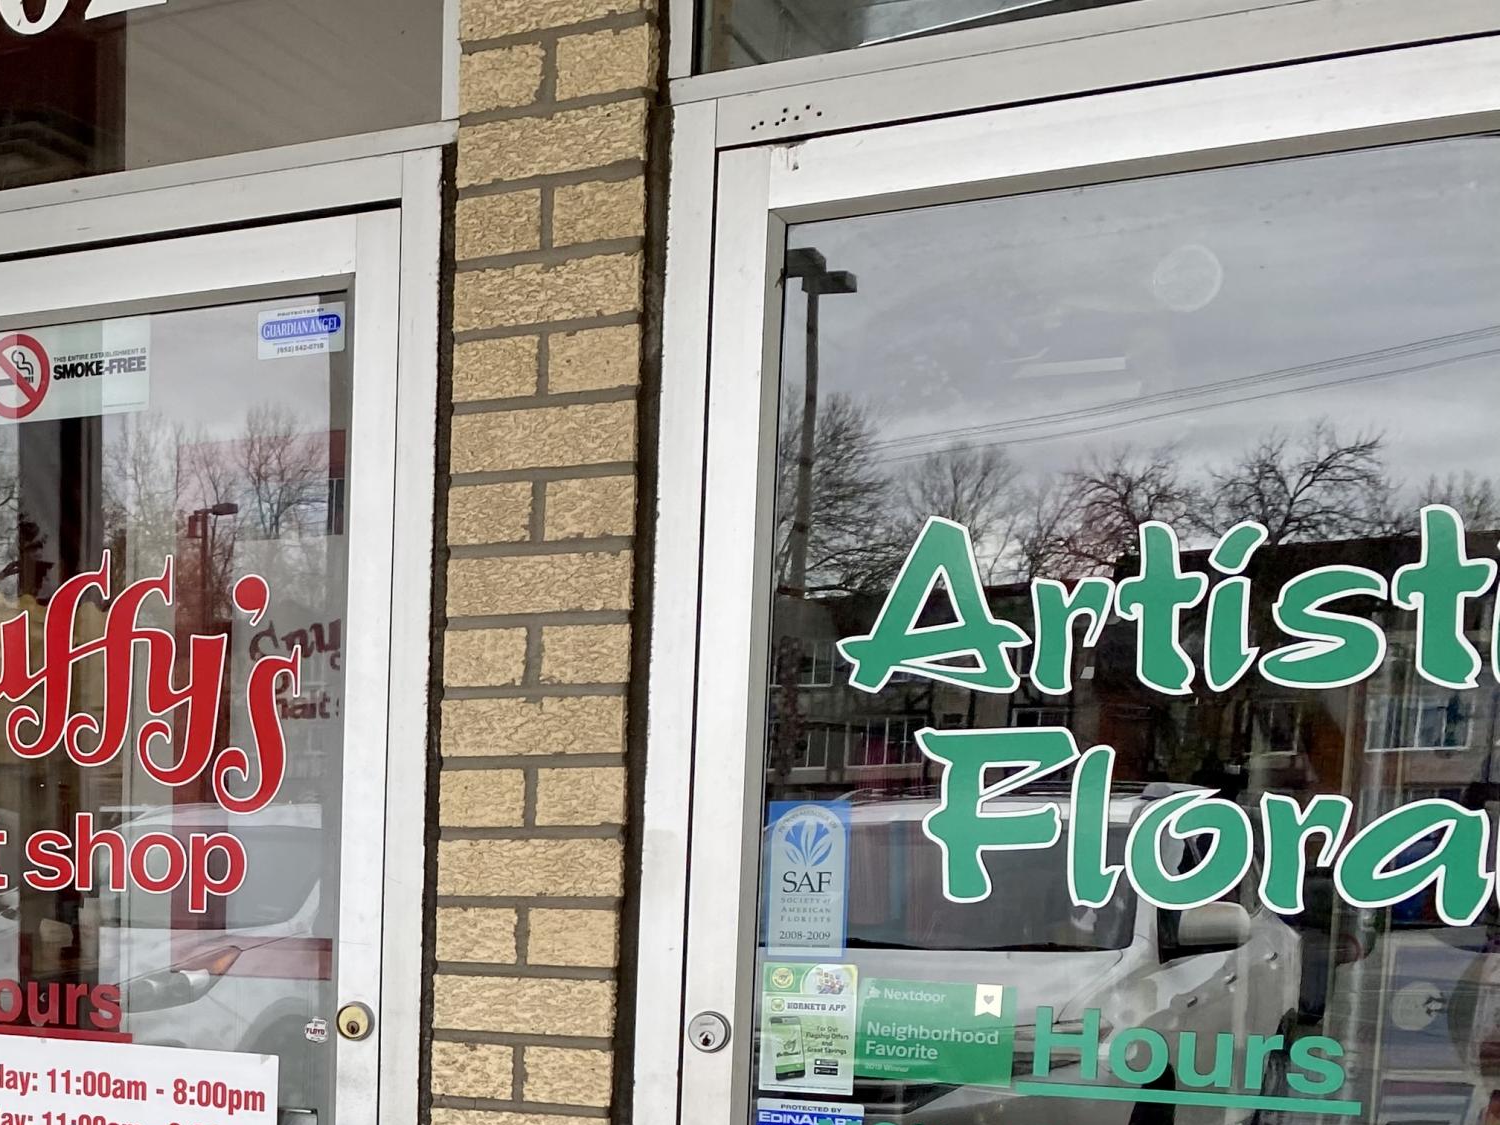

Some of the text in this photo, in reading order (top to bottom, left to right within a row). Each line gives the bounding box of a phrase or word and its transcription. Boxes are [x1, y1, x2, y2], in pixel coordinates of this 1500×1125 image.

[263, 316, 338, 338] GUARDIAN ANGEL
[53, 355, 66, 363] THIS
[67, 352, 89, 362] ENTIRE
[53, 355, 147, 381] SMOKE-FREE
[837, 503, 1500, 694] Artist
[914, 726, 1500, 926] Flora
[23, 812, 248, 914] shop
[782, 871, 832, 893] SAF
[780, 914, 831, 923] FLORISTS
[781, 906, 831, 914] AMERICAN
[779, 930, 831, 941] 2008-2009
[884, 987, 946, 1003] Nextdoor
[787, 1001, 847, 1012] HORNETS APP
[805, 1031, 849, 1041] Flagship Offers
[866, 1021, 999, 1045] Neighborhood
[824, 1047, 847, 1056] Savings
[865, 1040, 939, 1060] Favorite
[1034, 1006, 1346, 1095] Hours
[883, 1063, 909, 1073] Winner
[46, 1068, 148, 1102] 11:00am
[173, 1078, 266, 1117] 8:00pm
[781, 1103, 829, 1113] PROTECTED
